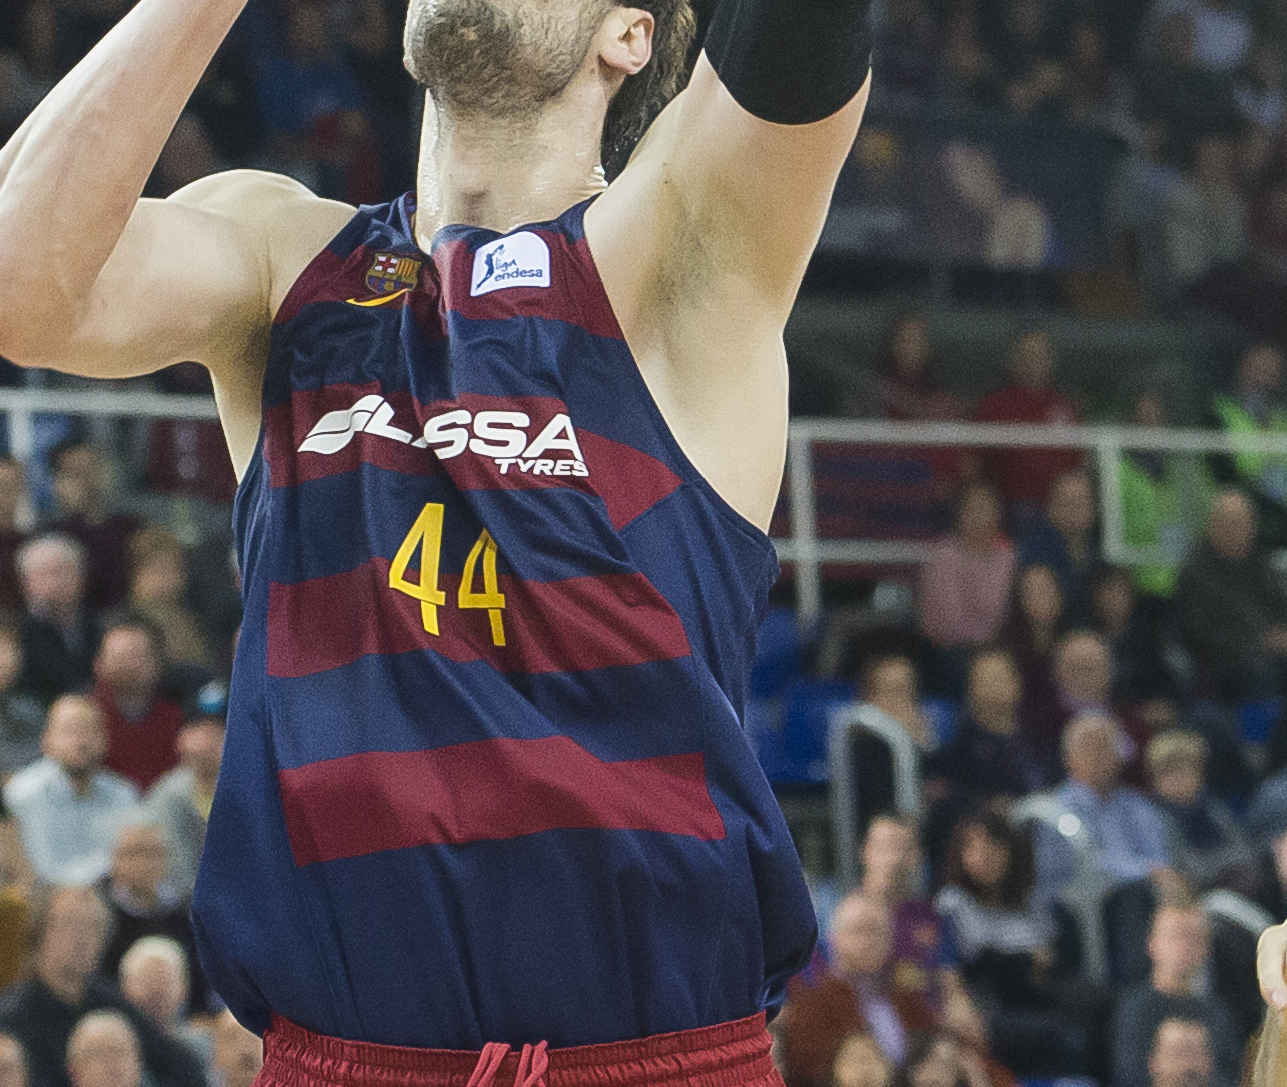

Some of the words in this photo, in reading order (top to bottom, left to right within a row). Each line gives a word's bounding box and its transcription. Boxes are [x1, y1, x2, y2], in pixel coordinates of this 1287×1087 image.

[494, 268, 543, 282] endesa
[364, 400, 584, 460] LSSA
[494, 458, 589, 477] TYRES
[388, 502, 507, 647] 44
